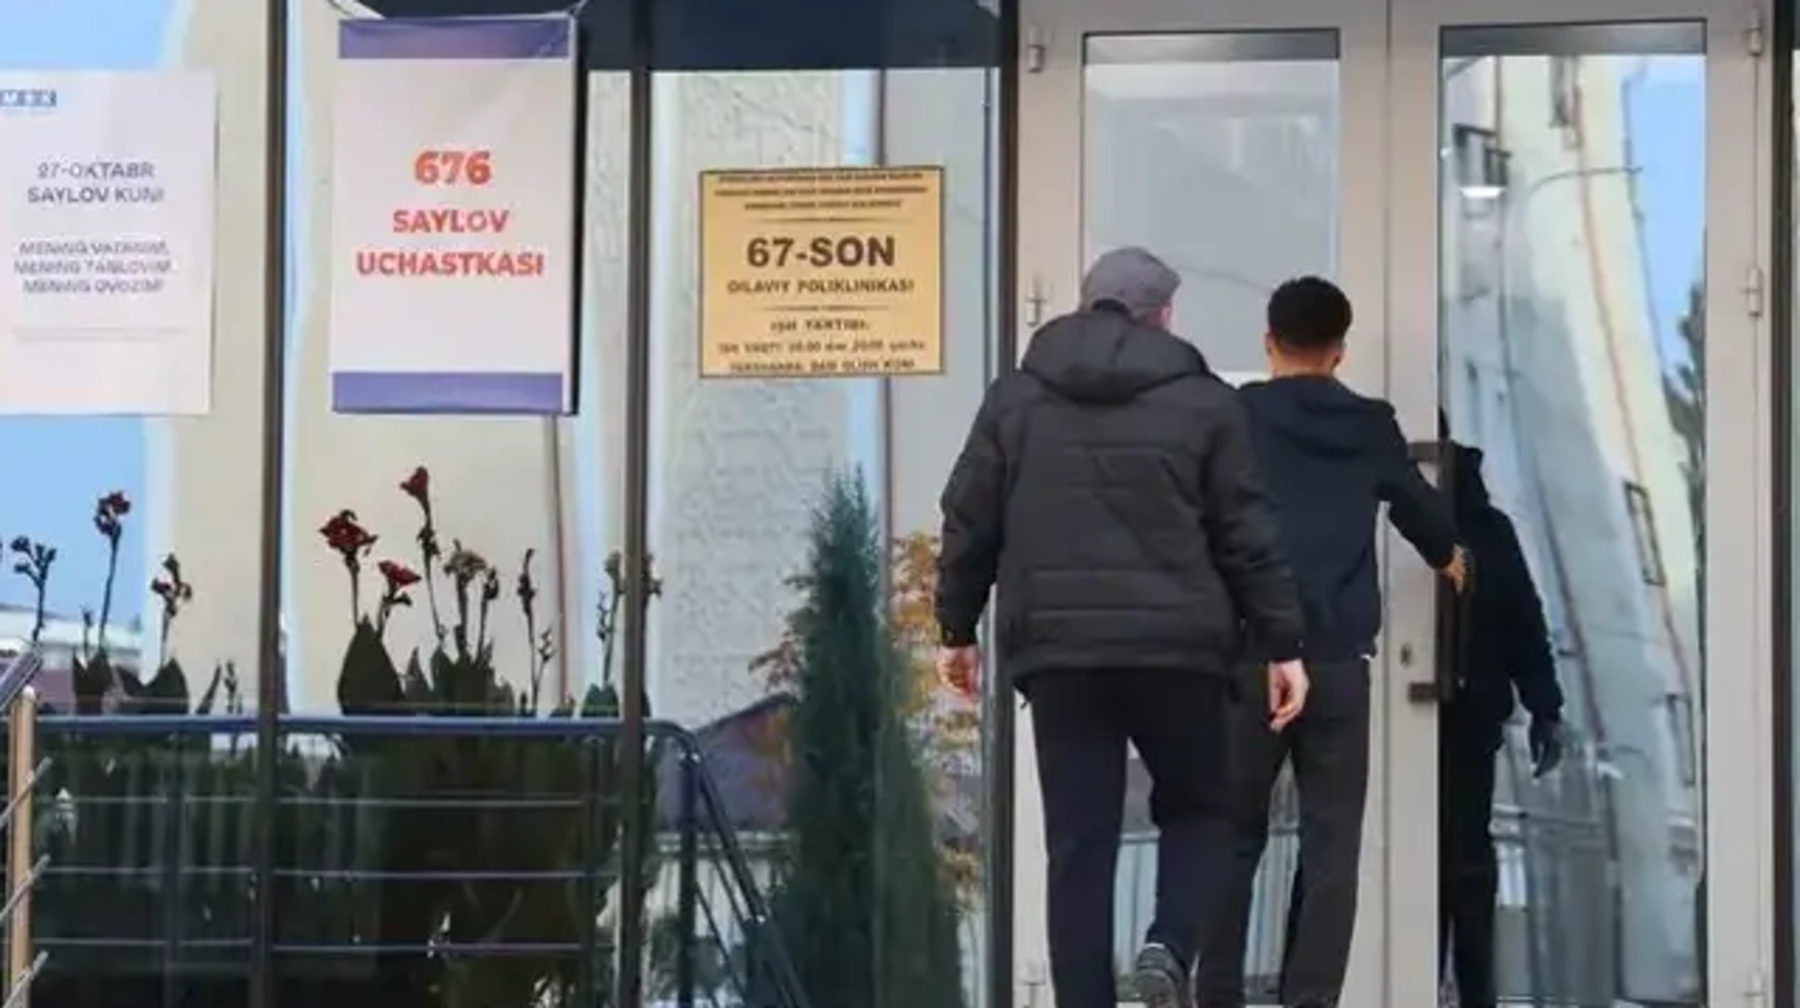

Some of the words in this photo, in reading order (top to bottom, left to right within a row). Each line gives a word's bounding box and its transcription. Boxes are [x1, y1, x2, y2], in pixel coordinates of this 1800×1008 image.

[36, 161, 155, 180] 27-OKTABR
[413, 150, 492, 185] 676
[27, 186, 109, 204] SAYLOV
[392, 209, 511, 234] SAYLOV
[356, 251, 545, 276] UCHASTKASI
[746, 235, 896, 268] 67-SON
[727, 279, 791, 294] OILAVIY
[797, 279, 915, 293] POLIKLINIKASI
